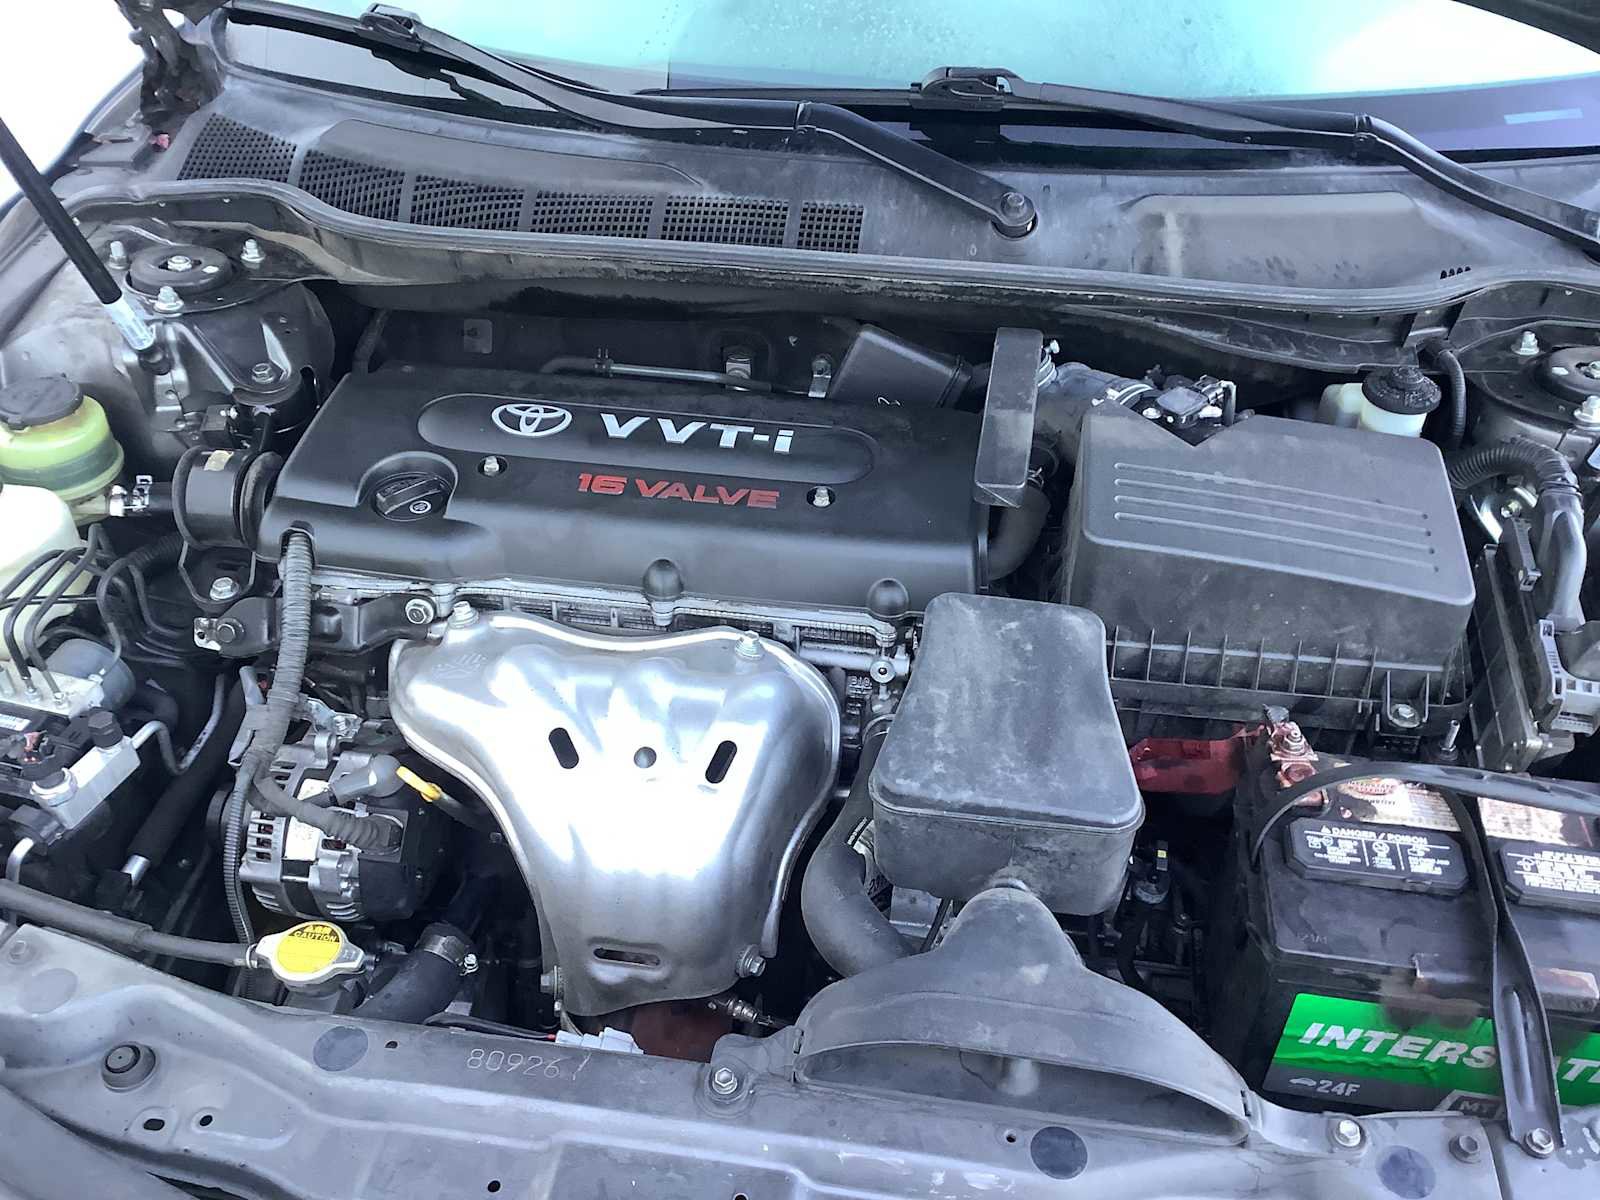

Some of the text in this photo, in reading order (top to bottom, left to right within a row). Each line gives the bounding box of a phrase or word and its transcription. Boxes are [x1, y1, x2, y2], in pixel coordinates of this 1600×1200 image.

[600, 412, 795, 454] VVT-i
[577, 472, 780, 509] 16 VALVE
[1332, 827, 1377, 840] DANGER
[1387, 832, 1428, 845] POISON
[294, 930, 337, 941] CAUTION
[1316, 1078, 1361, 1098] 24F
